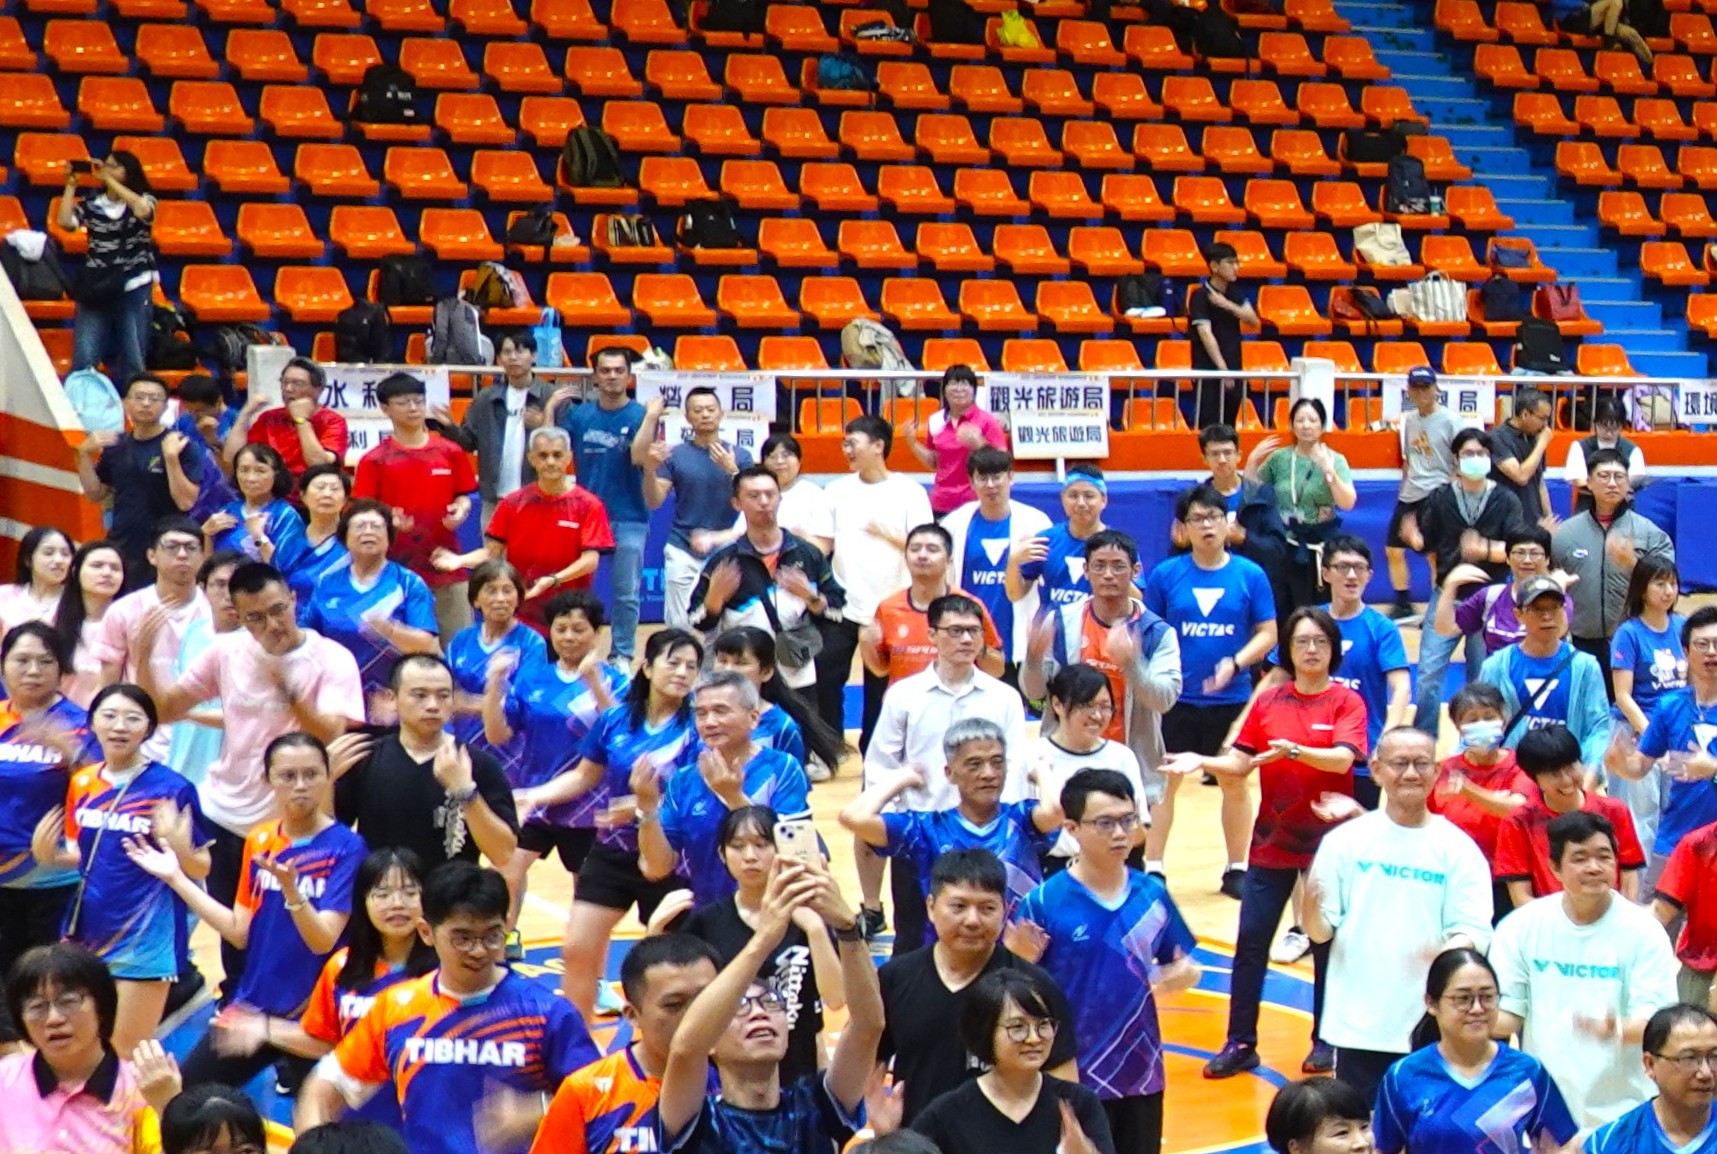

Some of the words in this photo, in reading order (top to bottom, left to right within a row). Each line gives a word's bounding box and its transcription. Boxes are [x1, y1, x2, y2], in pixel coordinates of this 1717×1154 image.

[990, 386, 1103, 413] 觀光旅遊局
[1018, 425, 1102, 443] 觀光旅遊局
[1182, 621, 1235, 637] VICTAS
[1379, 862, 1445, 884] VICTOR
[406, 1038, 527, 1066] TIBHAR
